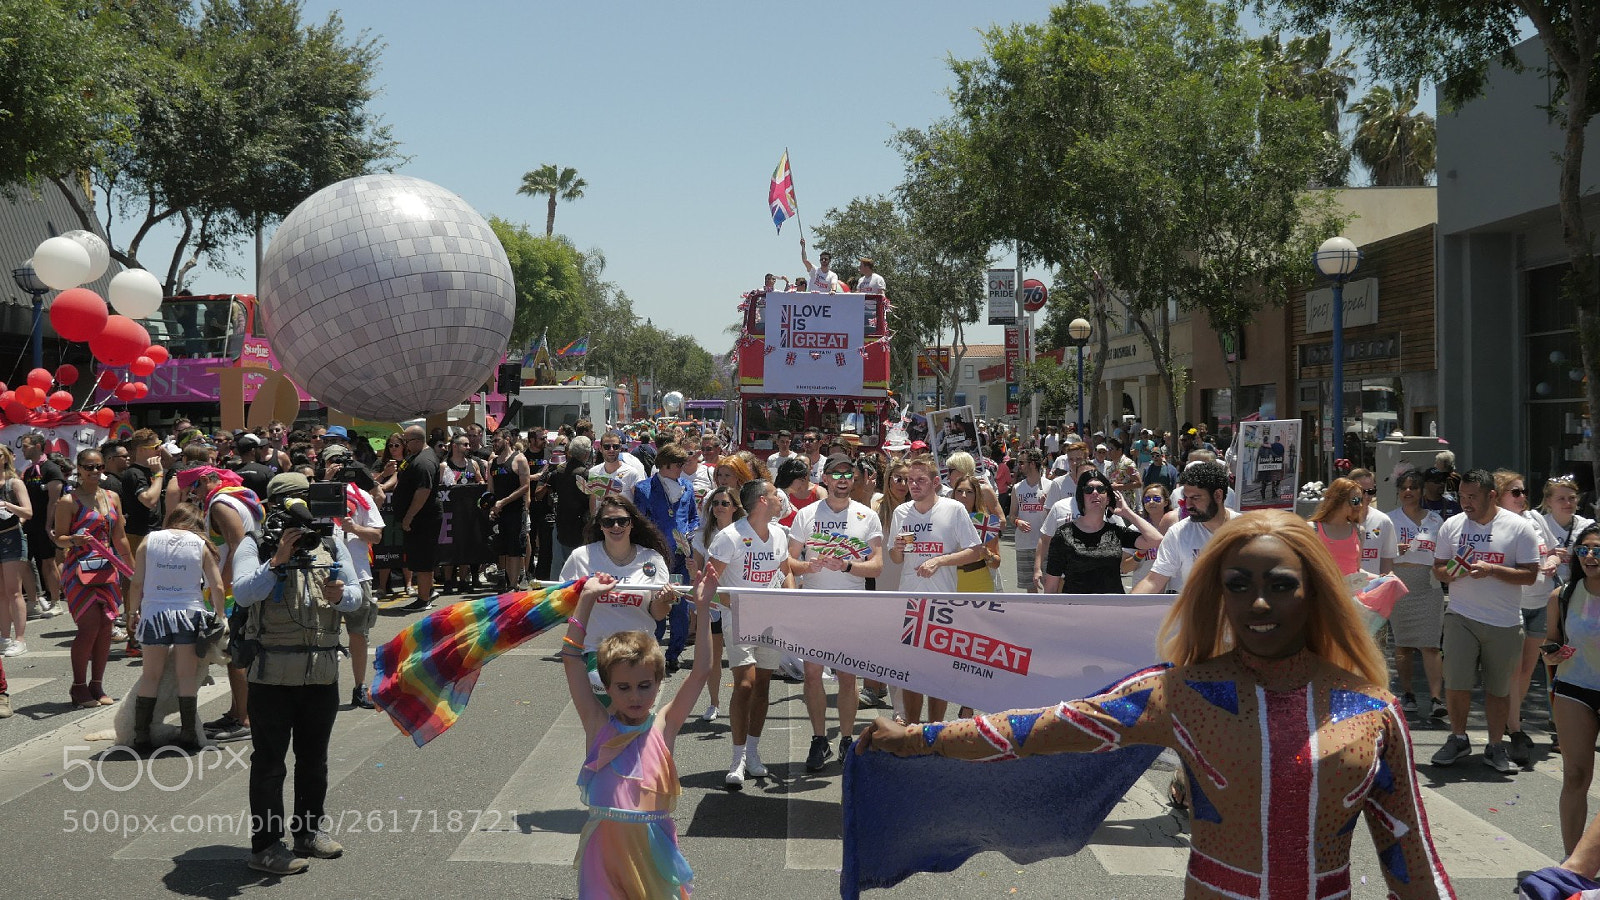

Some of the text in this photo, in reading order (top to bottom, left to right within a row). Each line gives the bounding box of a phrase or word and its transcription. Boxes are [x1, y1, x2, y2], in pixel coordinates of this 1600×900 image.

[989, 280, 1014, 290] ONE
[989, 290, 1014, 298] PRIDE
[1023, 285, 1045, 304] 76
[793, 304, 832, 318] LOVE
[793, 318, 806, 331] IS
[794, 333, 847, 348] GREAT
[821, 521, 848, 530] LOVE
[908, 523, 933, 533] LOVE
[1467, 533, 1494, 543] LOVE
[752, 551, 775, 561] LOVE
[1363, 549, 1377, 557] EAT
[1474, 551, 1504, 563] REAT
[752, 561, 760, 570] IS
[598, 592, 642, 606] GREAT
[928, 605, 954, 625] IS
[929, 628, 1028, 670] GREAT
[740, 633, 911, 683] visitbritain.com/loveisgreat
[952, 660, 994, 679] BRITAIN
